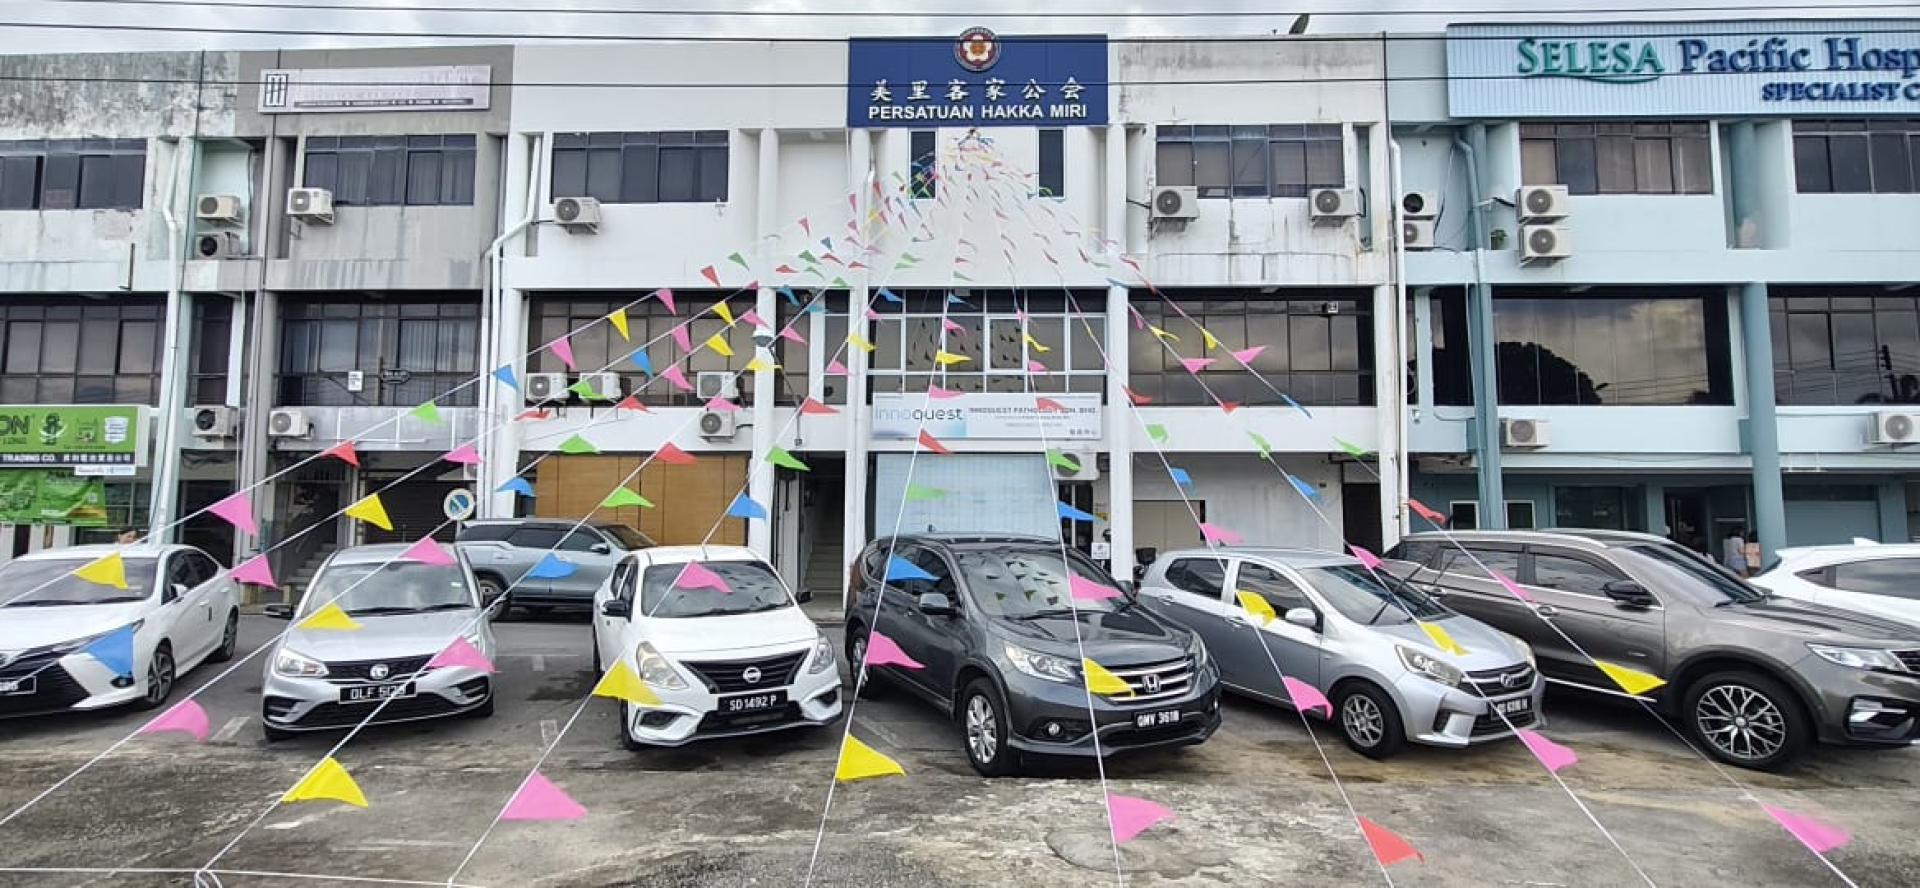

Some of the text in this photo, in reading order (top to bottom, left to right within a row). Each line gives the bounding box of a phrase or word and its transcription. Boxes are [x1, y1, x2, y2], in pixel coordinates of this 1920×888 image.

[1517, 37, 1920, 79] SELESA Pacific Hosp
[870, 77, 1085, 101] 美里客家公会
[1762, 82, 1900, 101] SPECIALIST
[868, 104, 1087, 120] PERSATUAN HAKKA MIRI
[875, 406, 962, 422] innoquest
[2, 453, 40, 462] TRADING
[729, 699, 743, 711] SD
[770, 694, 777, 706] P
